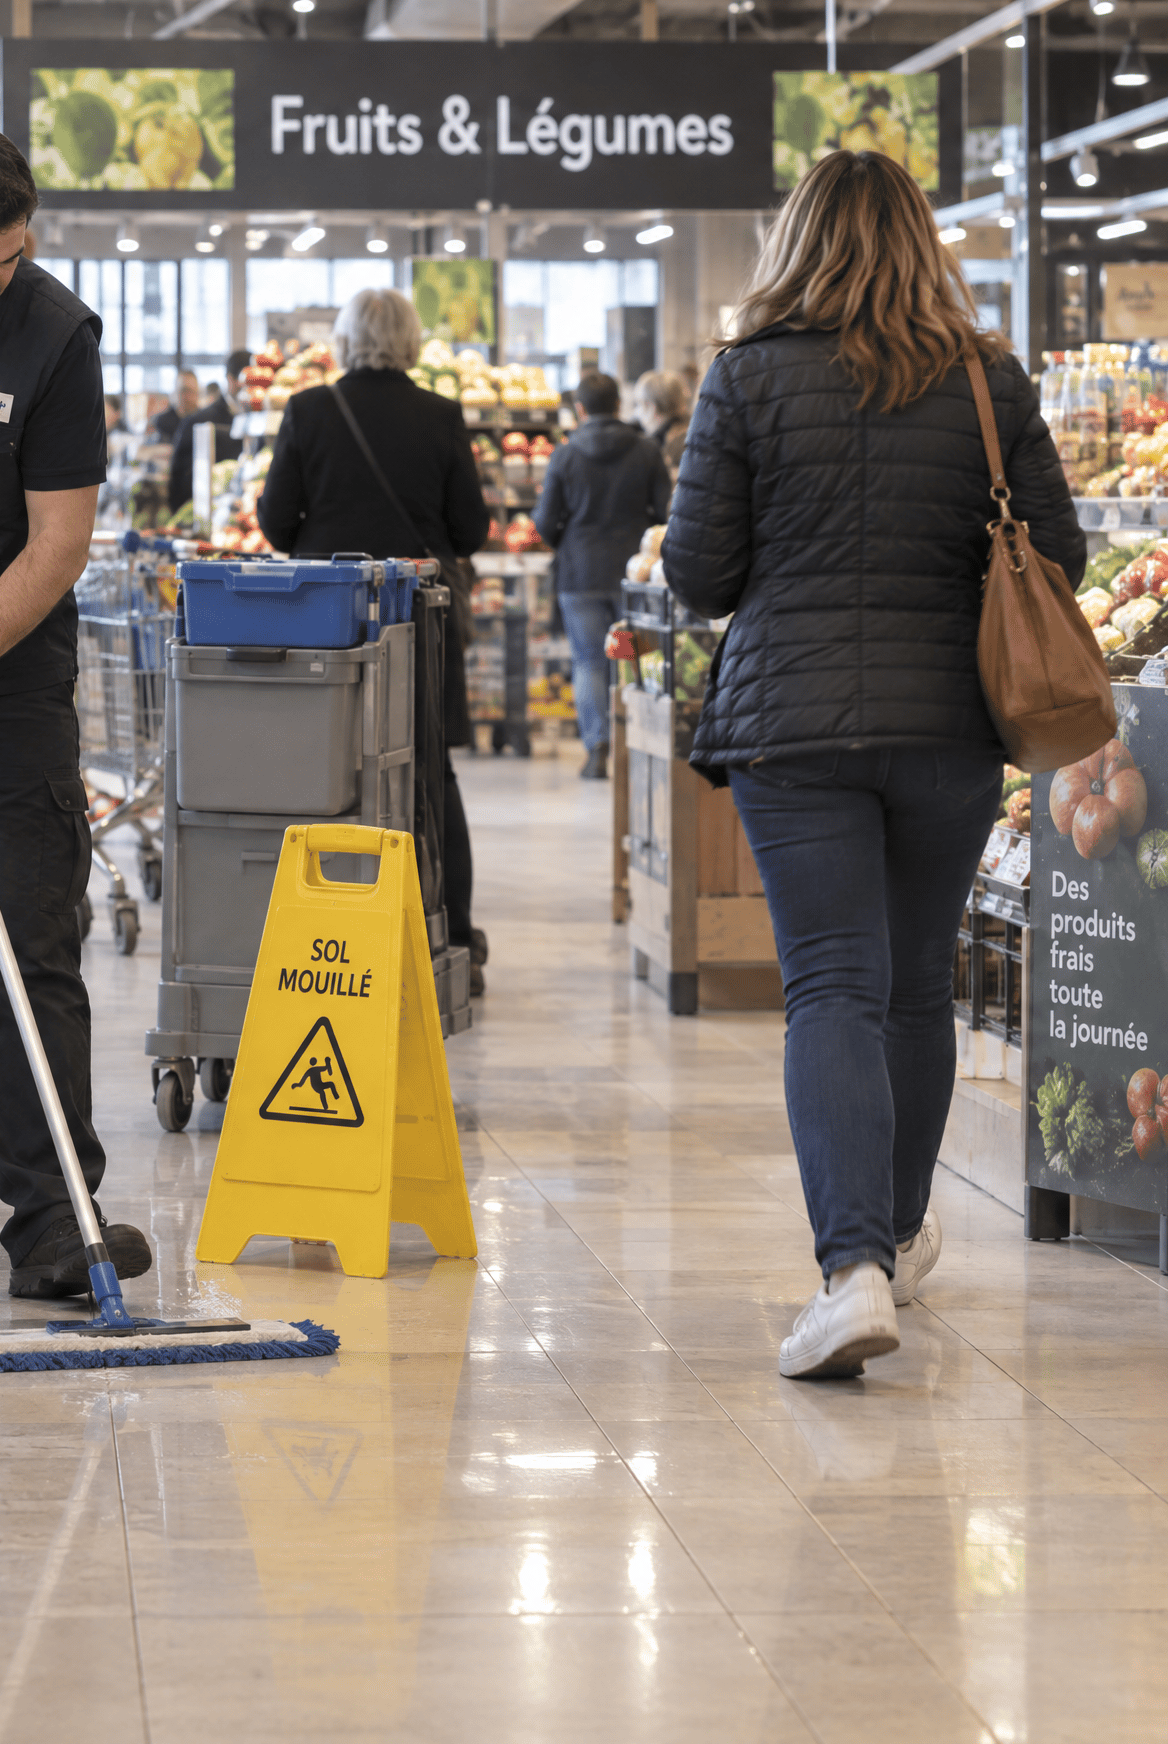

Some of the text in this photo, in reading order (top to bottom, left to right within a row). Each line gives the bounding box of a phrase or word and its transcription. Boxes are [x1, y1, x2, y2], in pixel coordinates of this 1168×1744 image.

[271, 95, 734, 172] Fruits & Légumes
[1051, 870, 1090, 901] Des
[1050, 908, 1136, 942] produits
[310, 938, 350, 964] SOL
[1049, 940, 1094, 973] frais
[277, 967, 373, 998] MOUILLÉ
[1049, 979, 1103, 1009] toute
[1049, 1009, 1149, 1052] la journée
